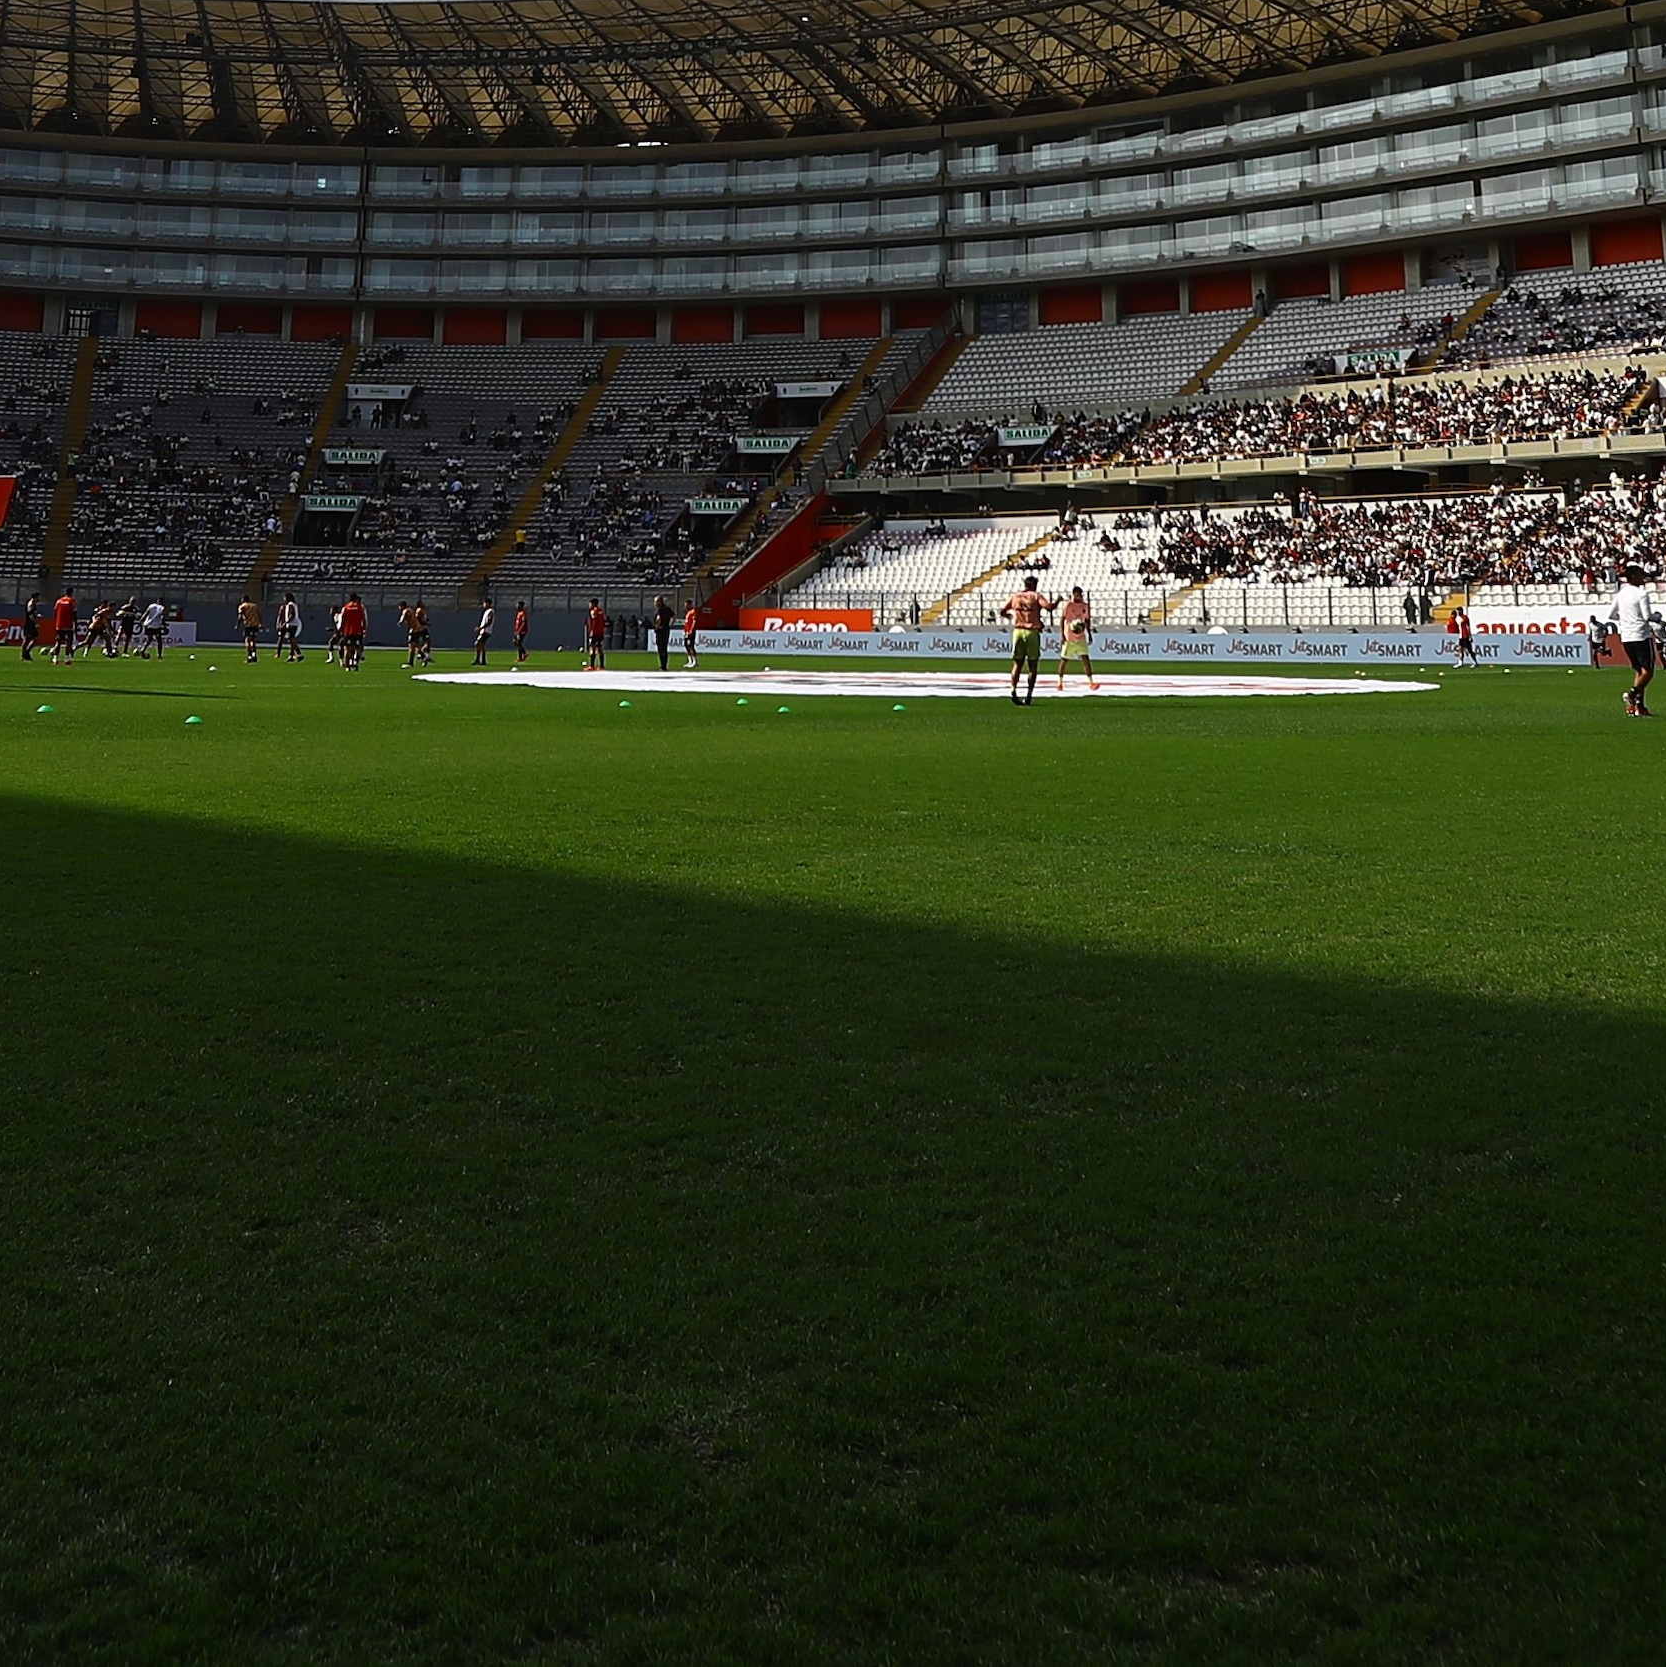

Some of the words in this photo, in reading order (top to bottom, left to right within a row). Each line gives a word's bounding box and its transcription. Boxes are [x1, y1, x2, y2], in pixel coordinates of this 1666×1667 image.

[1006, 429, 1048, 438] SALIDA
[745, 439, 790, 448] SALIDA
[331, 451, 376, 460] SALIDA
[309, 498, 356, 507] SALIDA
[694, 500, 742, 511] SALIDA
[738, 634, 776, 649] JetSMART
[784, 635, 823, 650] JetSMART
[827, 635, 869, 651] JetSMART
[877, 636, 920, 652] JetSMART
[928, 637, 973, 652] JetSMART
[1100, 638, 1151, 654] JetSMART
[1162, 638, 1215, 655] JetSMART
[1226, 638, 1282, 656] JetSMART
[1289, 638, 1347, 657] JetSMART
[1360, 638, 1421, 657] JetSMART
[1514, 639, 1582, 658] JetSMART
